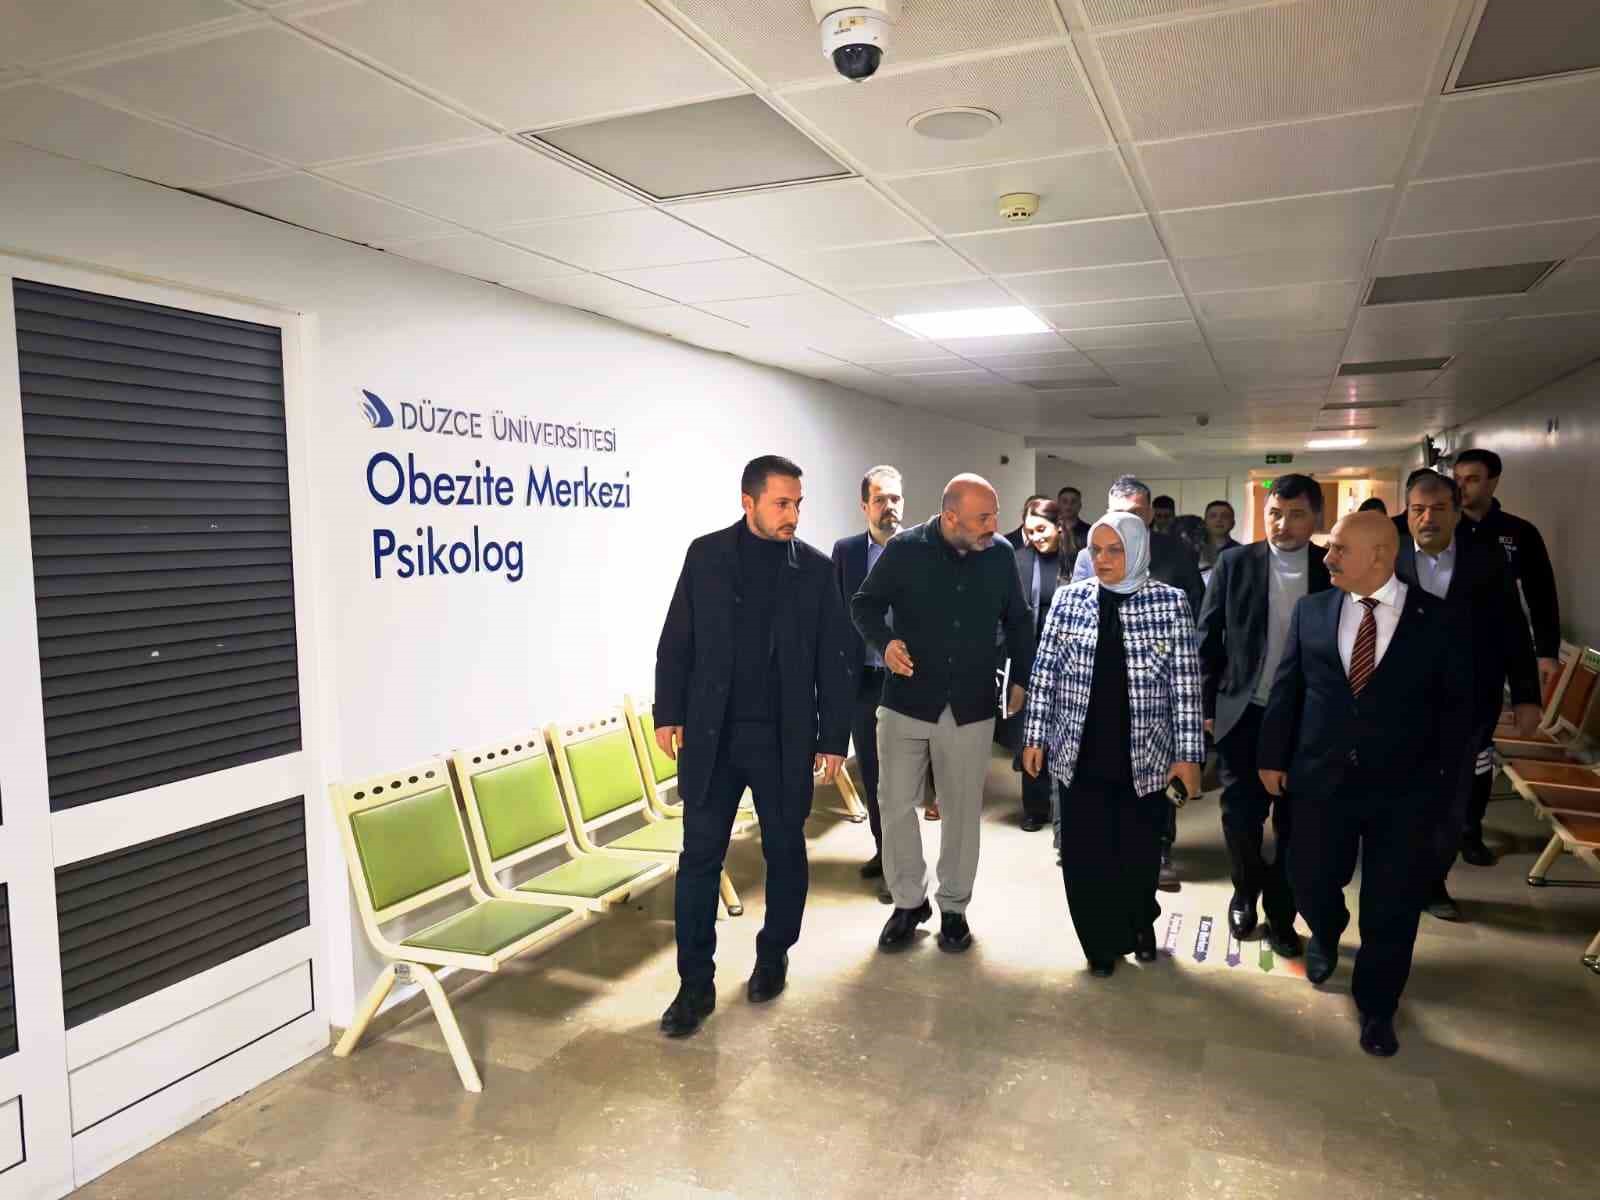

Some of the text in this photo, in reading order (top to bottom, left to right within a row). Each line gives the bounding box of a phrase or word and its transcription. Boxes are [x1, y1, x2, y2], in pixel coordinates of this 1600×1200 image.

[401, 400, 616, 452] DÜZCE ÜNİVERSİTESİ
[366, 452, 631, 508] Obezite Merkezi
[373, 525, 524, 582] Psikolog
